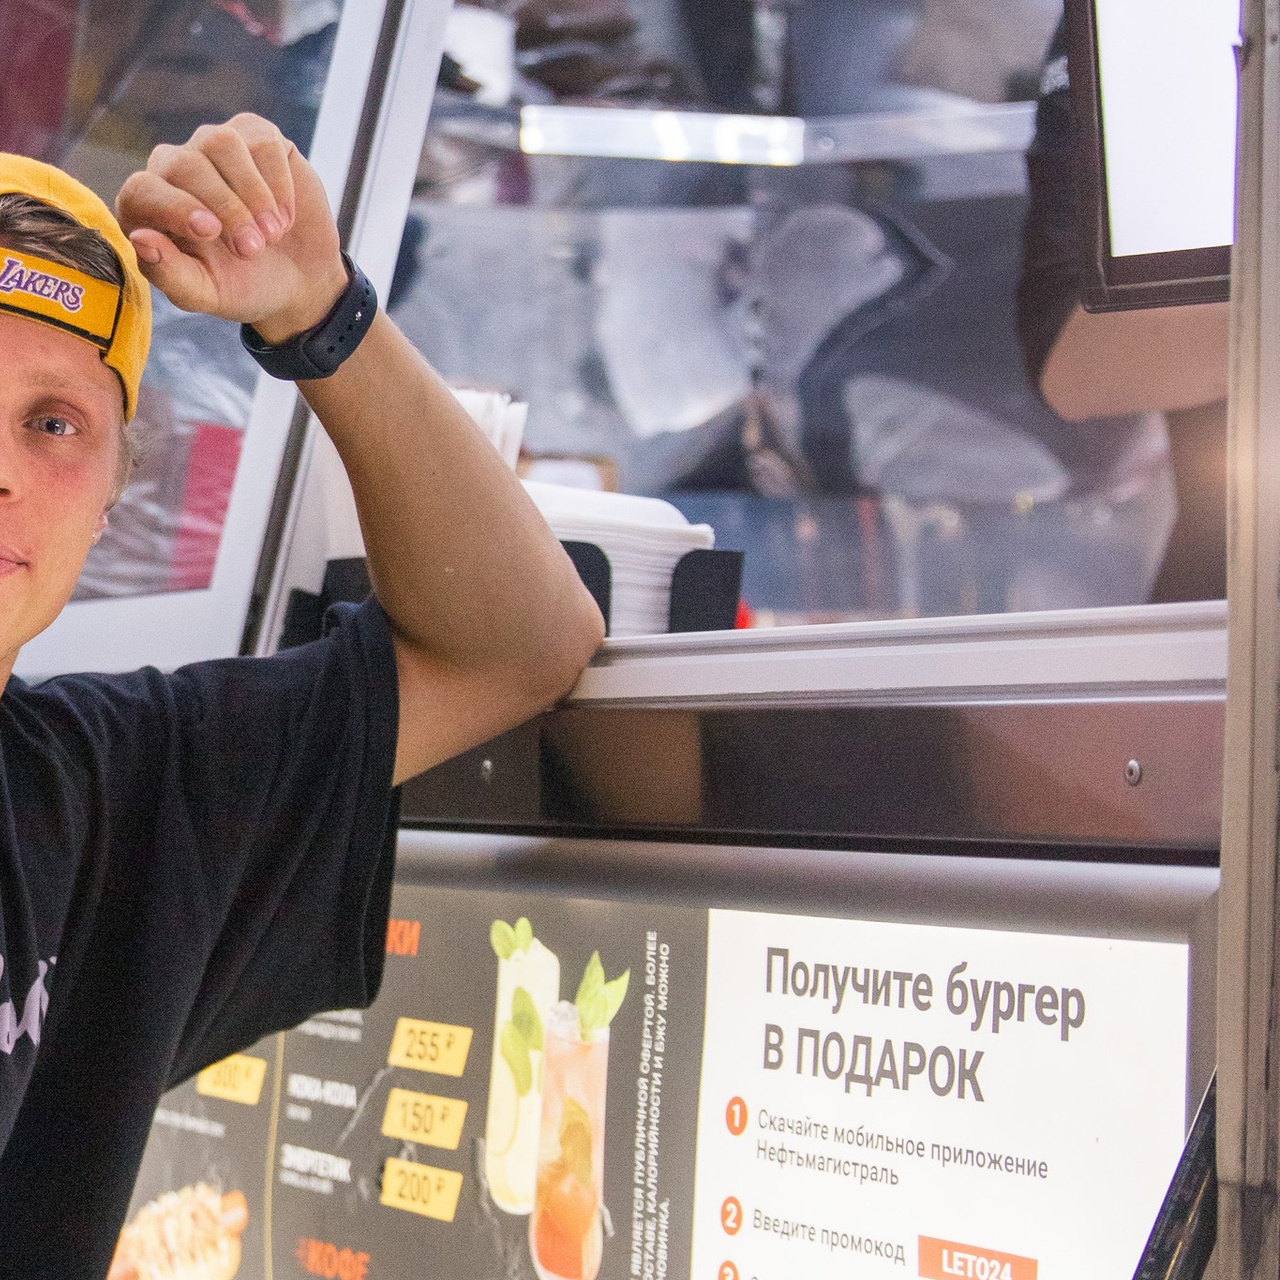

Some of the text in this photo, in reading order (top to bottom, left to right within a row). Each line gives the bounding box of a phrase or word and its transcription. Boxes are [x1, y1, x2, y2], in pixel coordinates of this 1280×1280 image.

[646, 930, 657, 986] БОЛЕЕ
[658, 942, 670, 1011] МОЖНО
[765, 946, 1086, 1041] Получите бургер
[405, 1025, 440, 1062] 255
[655, 1013, 667, 1052] БЖУ
[654, 1055, 663, 1070] И
[763, 1023, 985, 1102] В ПОДАРОК
[401, 1100, 434, 1133] 150
[634, 1077, 648, 1184] ПУБЛИЧНОЙ
[646, 1072, 662, 1214] КАЛОРИЙНОСТИ
[758, 1109, 1049, 1179] Скачайте мобильное приложение
[397, 1169, 431, 1204] 200
[756, 1139, 900, 1187] Нефтьмагистраль
[631, 1187, 644, 1276] ЯВЛЯЕТСЯ
[753, 1209, 816, 1243] Введите
[820, 1229, 906, 1266] промокод
